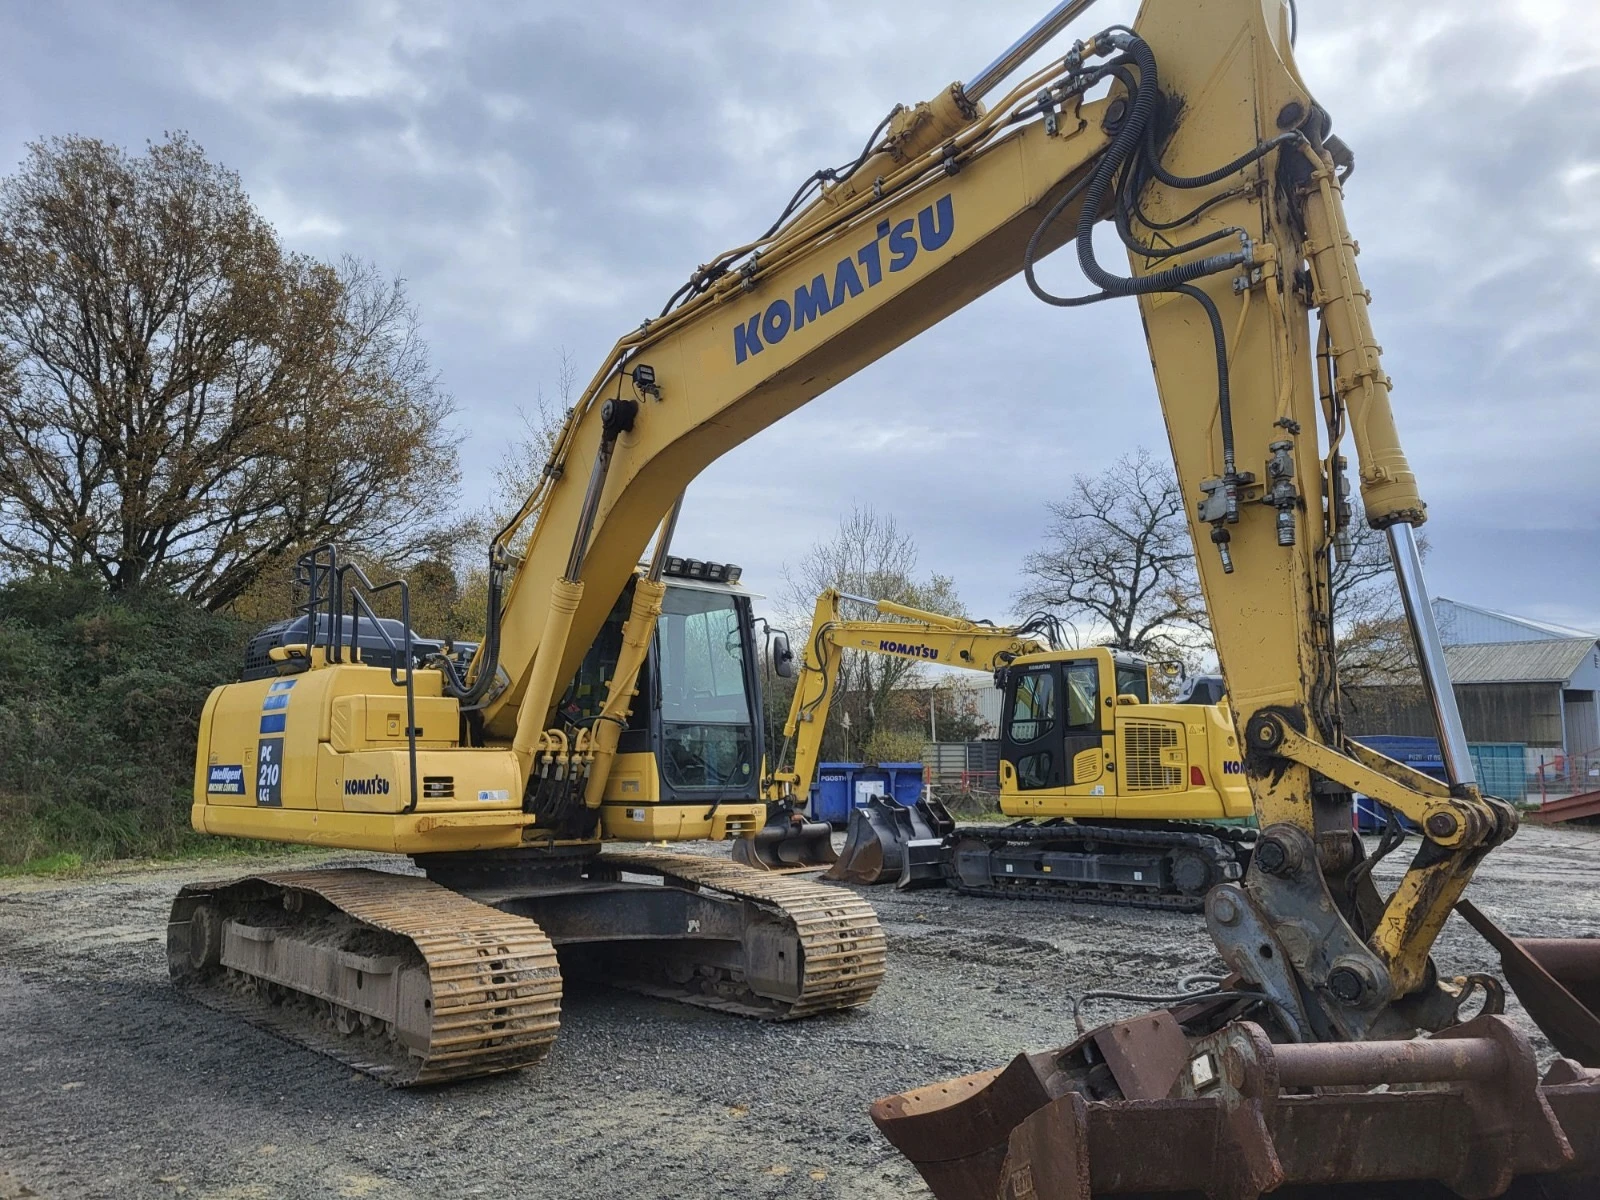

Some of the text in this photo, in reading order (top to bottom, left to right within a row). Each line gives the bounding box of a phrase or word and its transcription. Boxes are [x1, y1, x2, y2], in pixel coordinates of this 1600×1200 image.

[733, 193, 955, 366] KOMATSU
[879, 640, 939, 660] KOMATSU
[260, 745, 272, 762] PC
[259, 764, 279, 786] 210
[344, 774, 389, 795] KOMATSU
